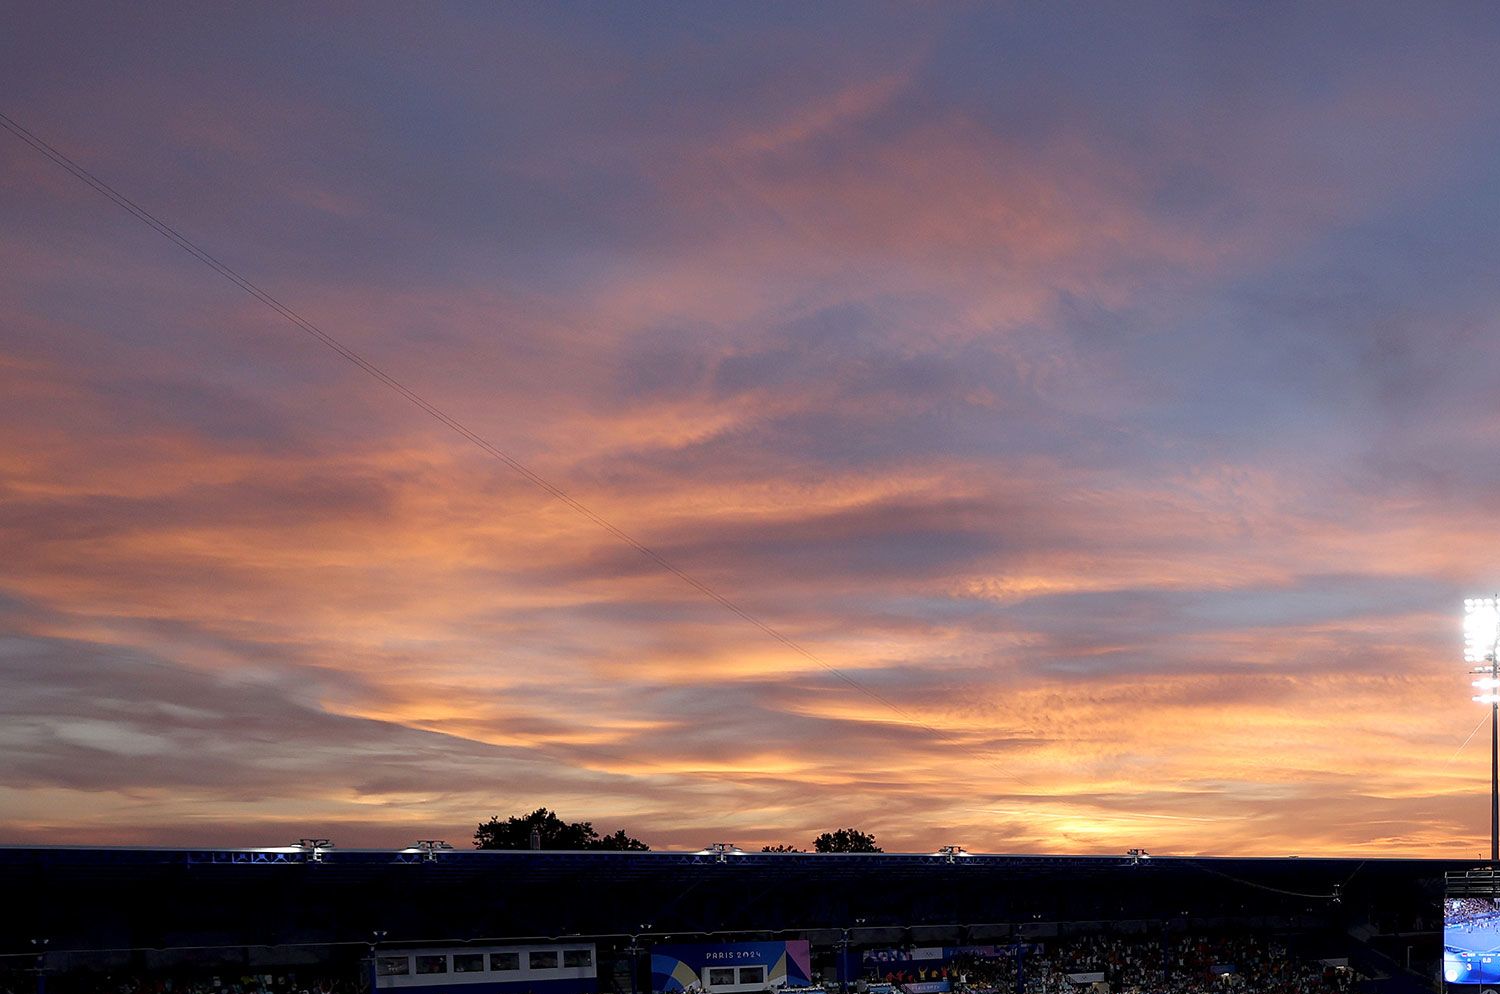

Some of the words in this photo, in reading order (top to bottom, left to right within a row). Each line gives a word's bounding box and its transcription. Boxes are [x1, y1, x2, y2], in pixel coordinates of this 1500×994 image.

[705, 951, 733, 960] PARIS
[736, 950, 761, 958] 2024
[1466, 963, 1472, 971] 3
